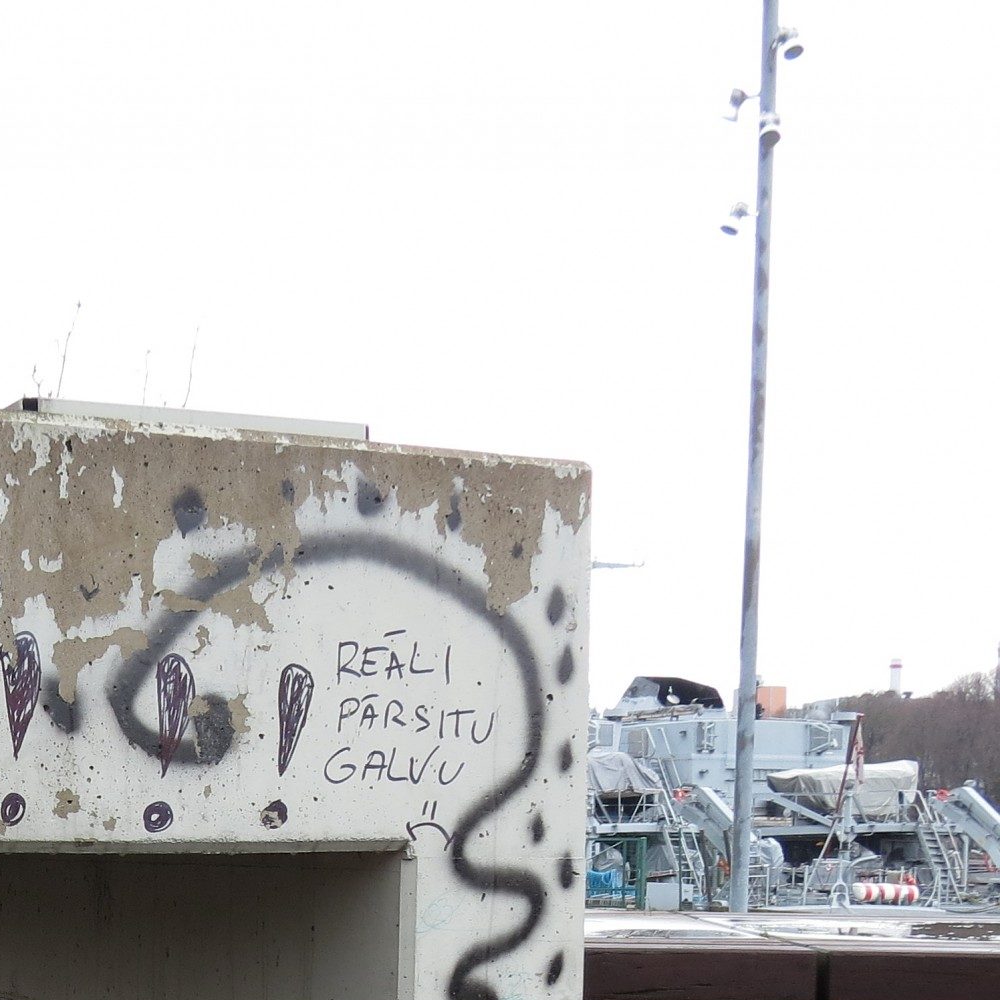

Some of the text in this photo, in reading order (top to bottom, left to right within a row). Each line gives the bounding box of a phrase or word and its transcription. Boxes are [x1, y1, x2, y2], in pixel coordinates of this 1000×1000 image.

[336, 629, 452, 685] REĀLI
[337, 693, 495, 744] PĀRSITU
[324, 745, 465, 785] GALVU
